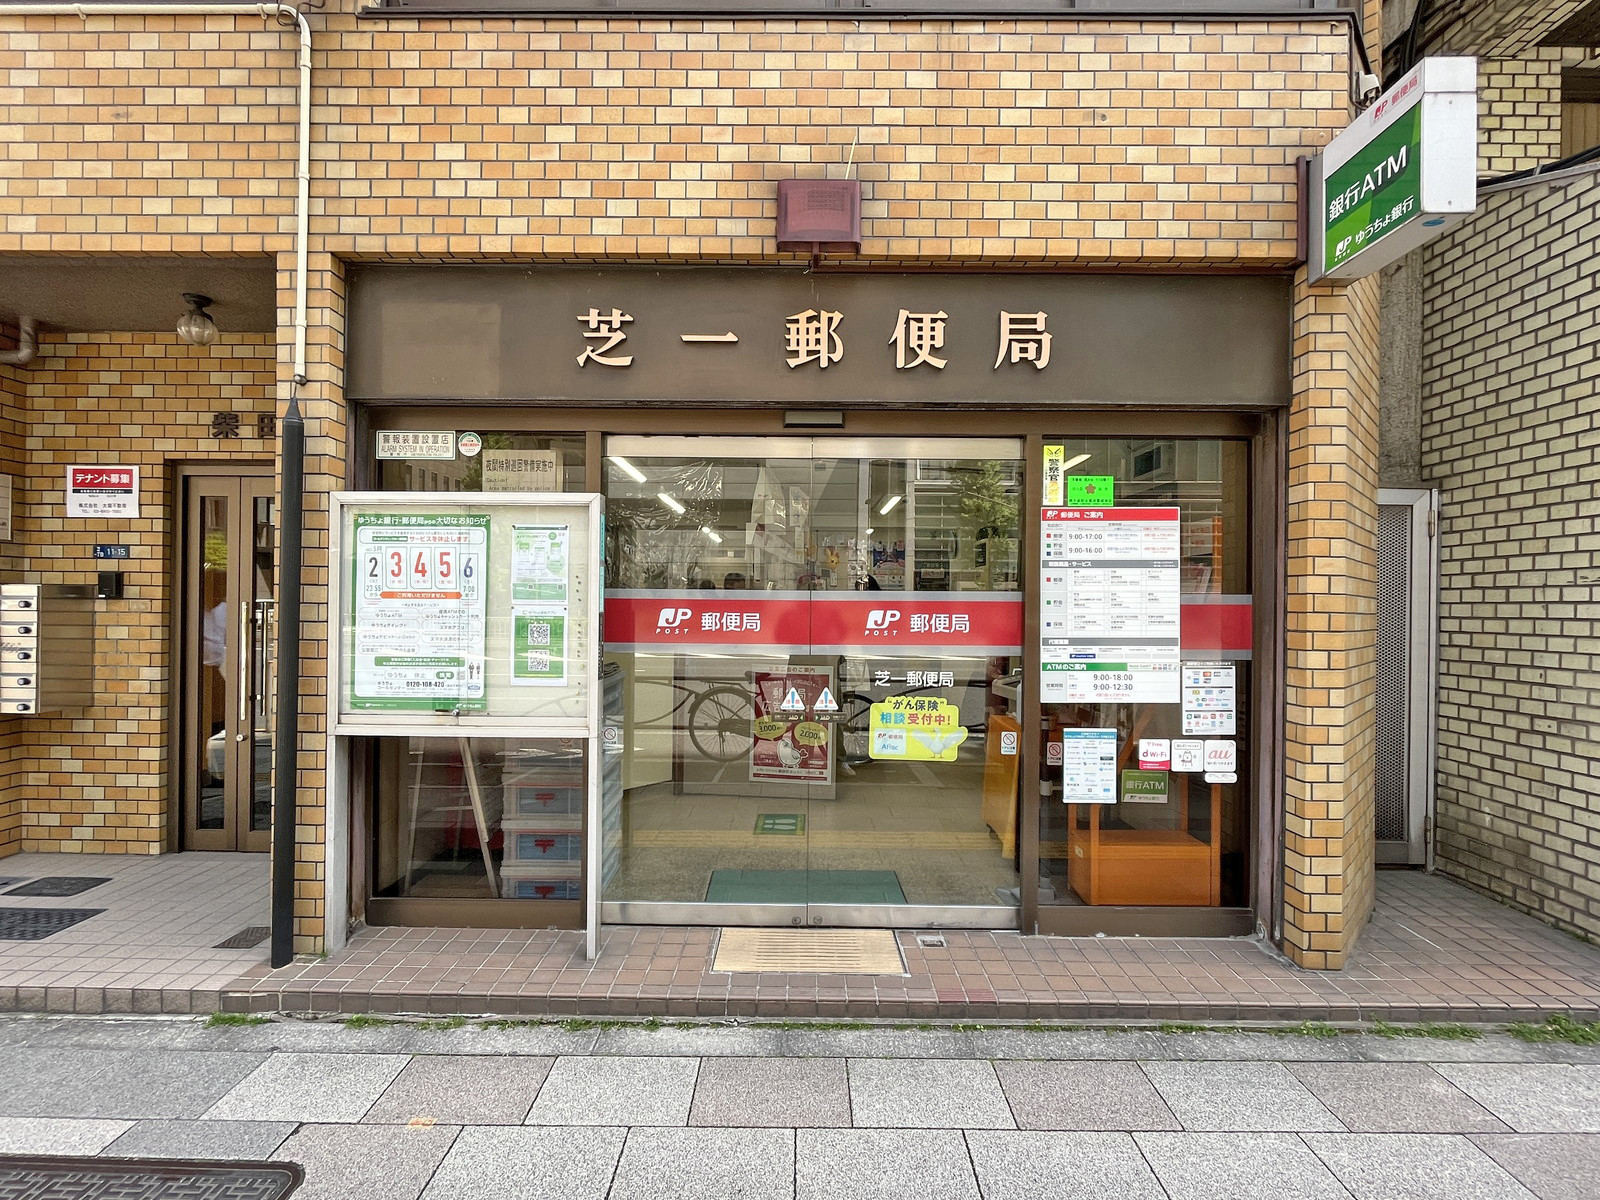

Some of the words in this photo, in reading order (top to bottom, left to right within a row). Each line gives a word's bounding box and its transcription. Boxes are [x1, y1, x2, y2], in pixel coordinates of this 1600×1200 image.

[1328, 144, 1406, 222] 銀行ATM
[1354, 194, 1414, 244] ゆうちょ銀行
[576, 308, 1053, 370] 芝一郵便局
[382, 434, 449, 444] 警報装置設置店
[75, 474, 130, 484] テナント募集
[369, 557, 378, 577] 2
[391, 552, 402, 577] 3
[414, 552, 427, 577] 4
[440, 552, 451, 577] 5
[464, 558, 473, 578] 6
[701, 612, 761, 632] 郵便局
[910, 614, 970, 634] 郵便局
[874, 671, 954, 687] 芝一郵便局
[1208, 749, 1232, 759] au
[1126, 780, 1164, 790] 銀行ATM
